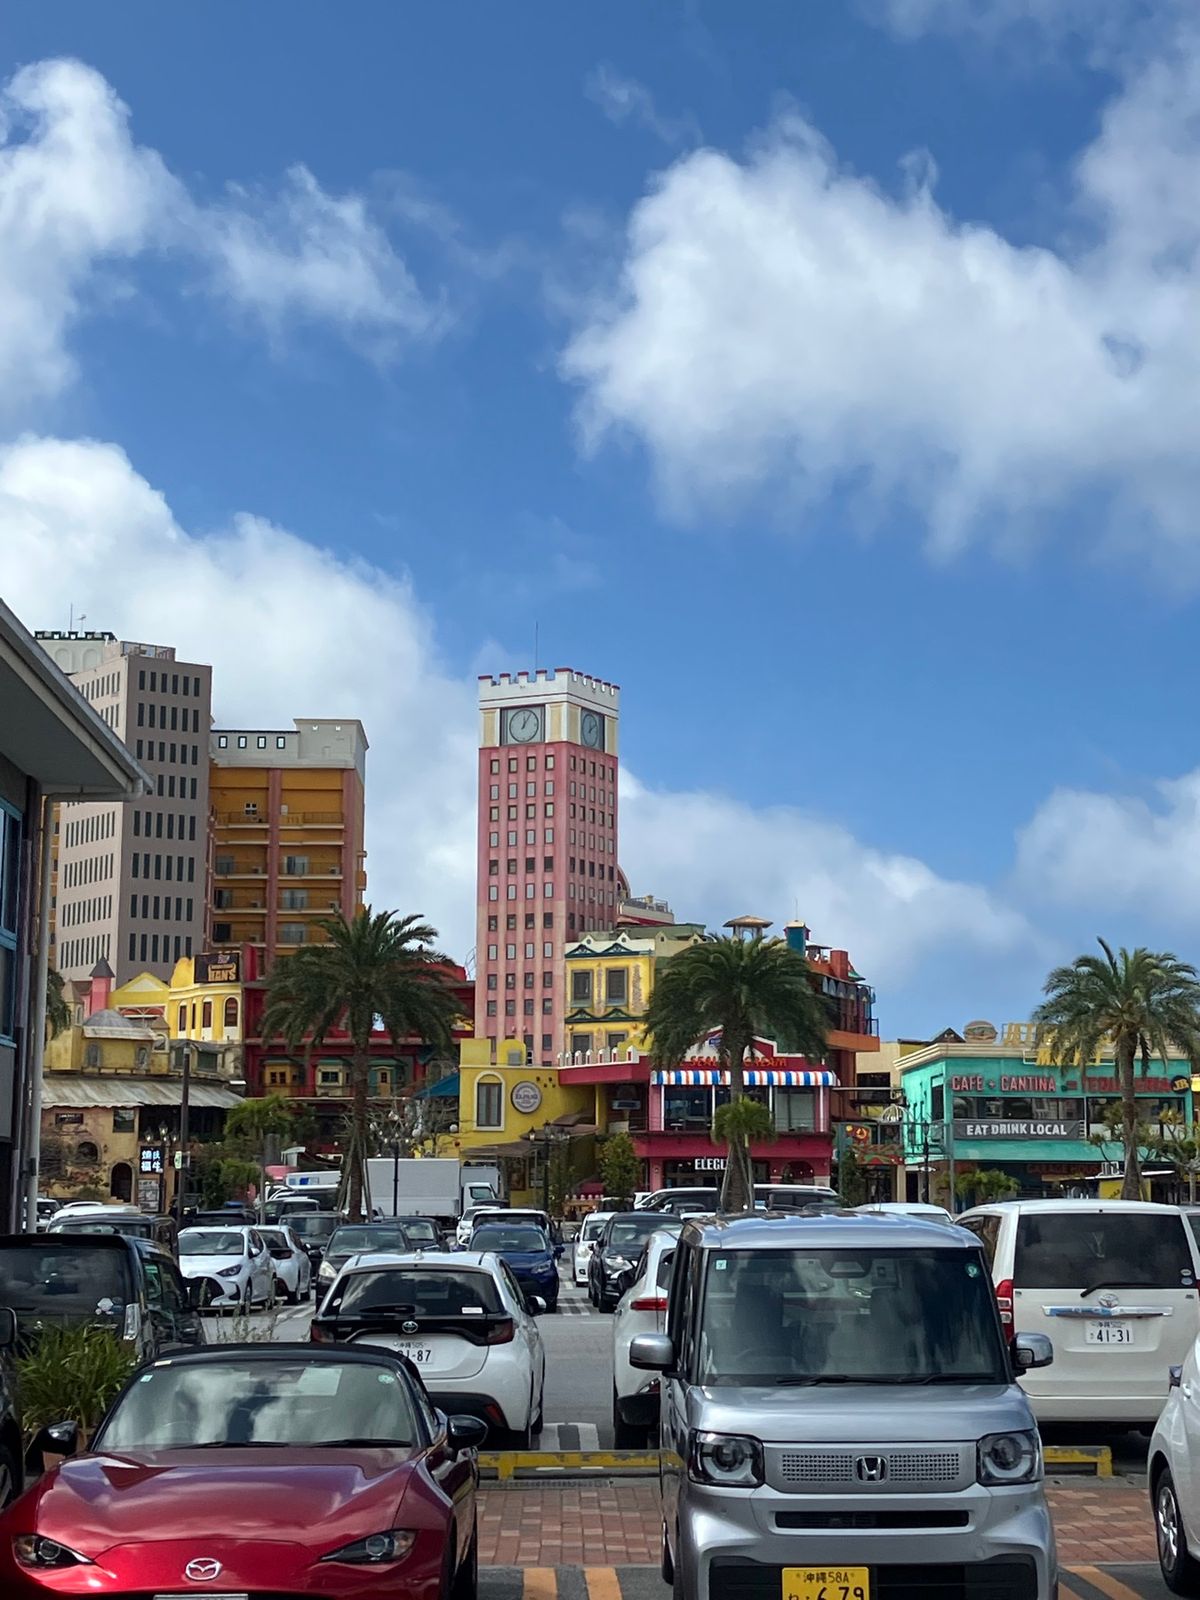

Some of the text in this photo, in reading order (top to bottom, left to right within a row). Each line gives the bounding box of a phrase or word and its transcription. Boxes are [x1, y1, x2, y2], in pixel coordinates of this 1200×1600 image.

[951, 1076, 983, 1091] CAFE
[1000, 1076, 1056, 1092] CANTINA
[966, 1123, 1067, 1136] EAT DRINK LOCAL
[1097, 1329, 1130, 1342] 41-31
